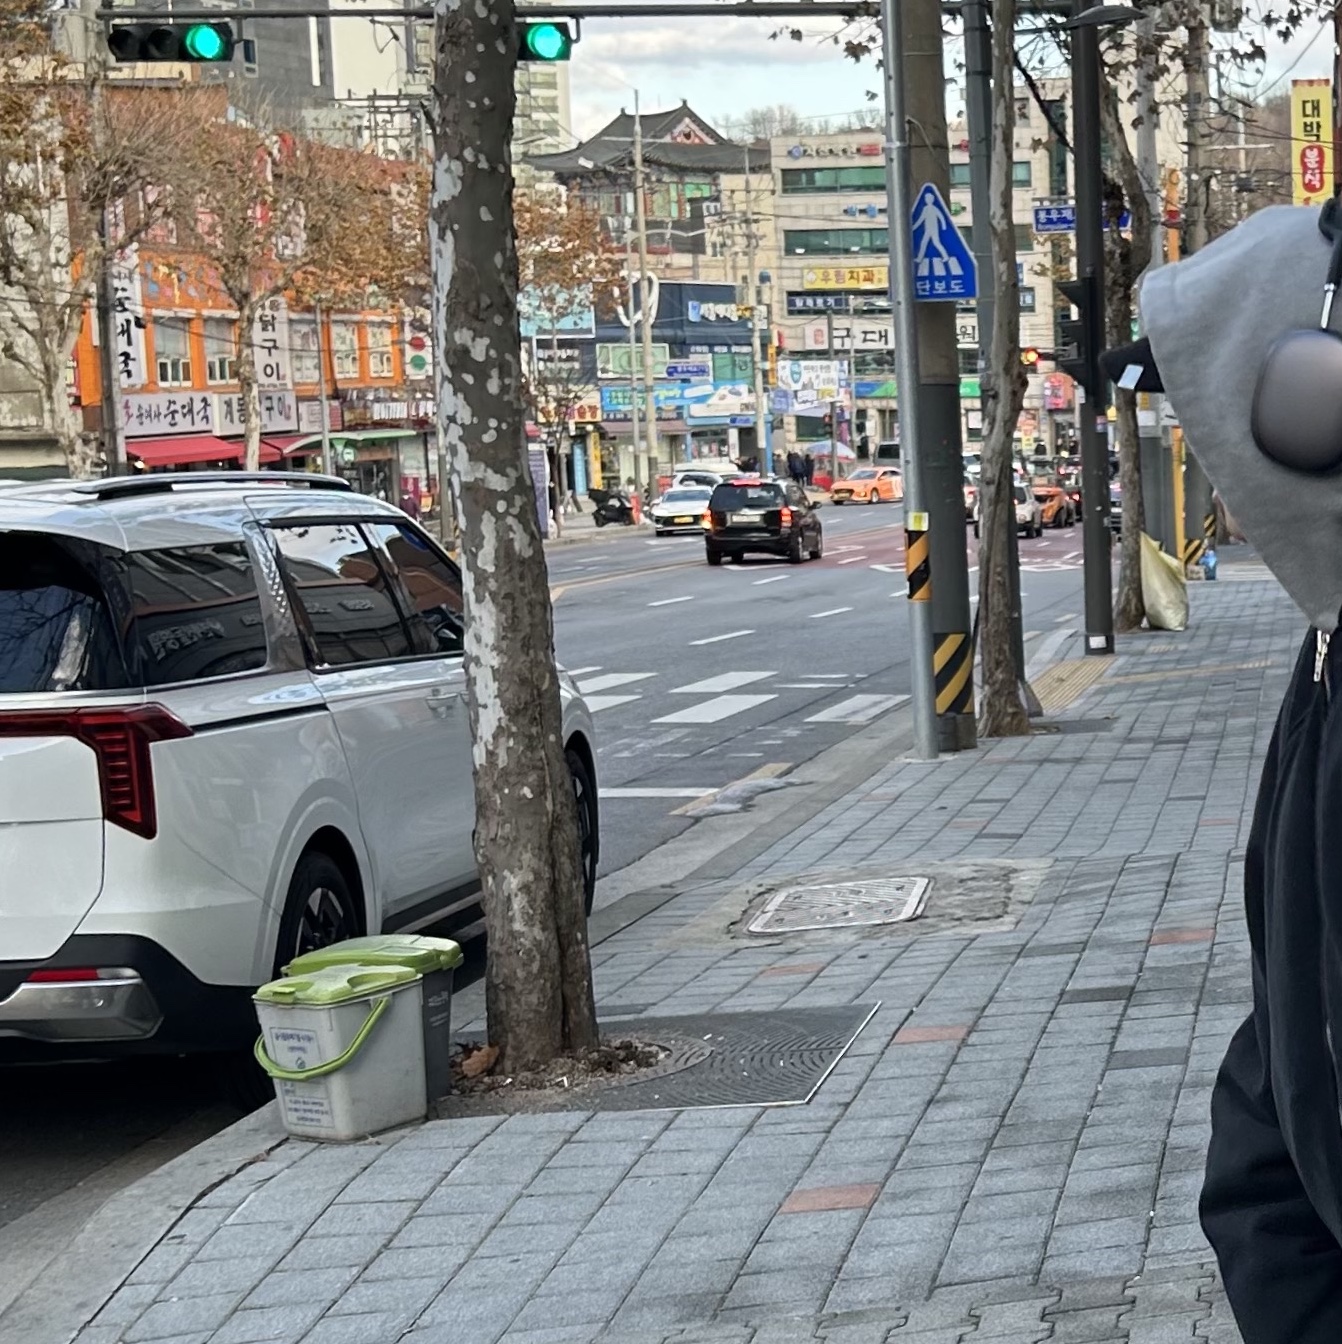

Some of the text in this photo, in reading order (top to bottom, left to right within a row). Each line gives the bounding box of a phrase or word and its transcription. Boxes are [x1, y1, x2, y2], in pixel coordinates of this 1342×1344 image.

[1301, 98, 1322, 142] 대박
[916, 280, 965, 296] 단보도
[163, 395, 212, 427] 순대국
